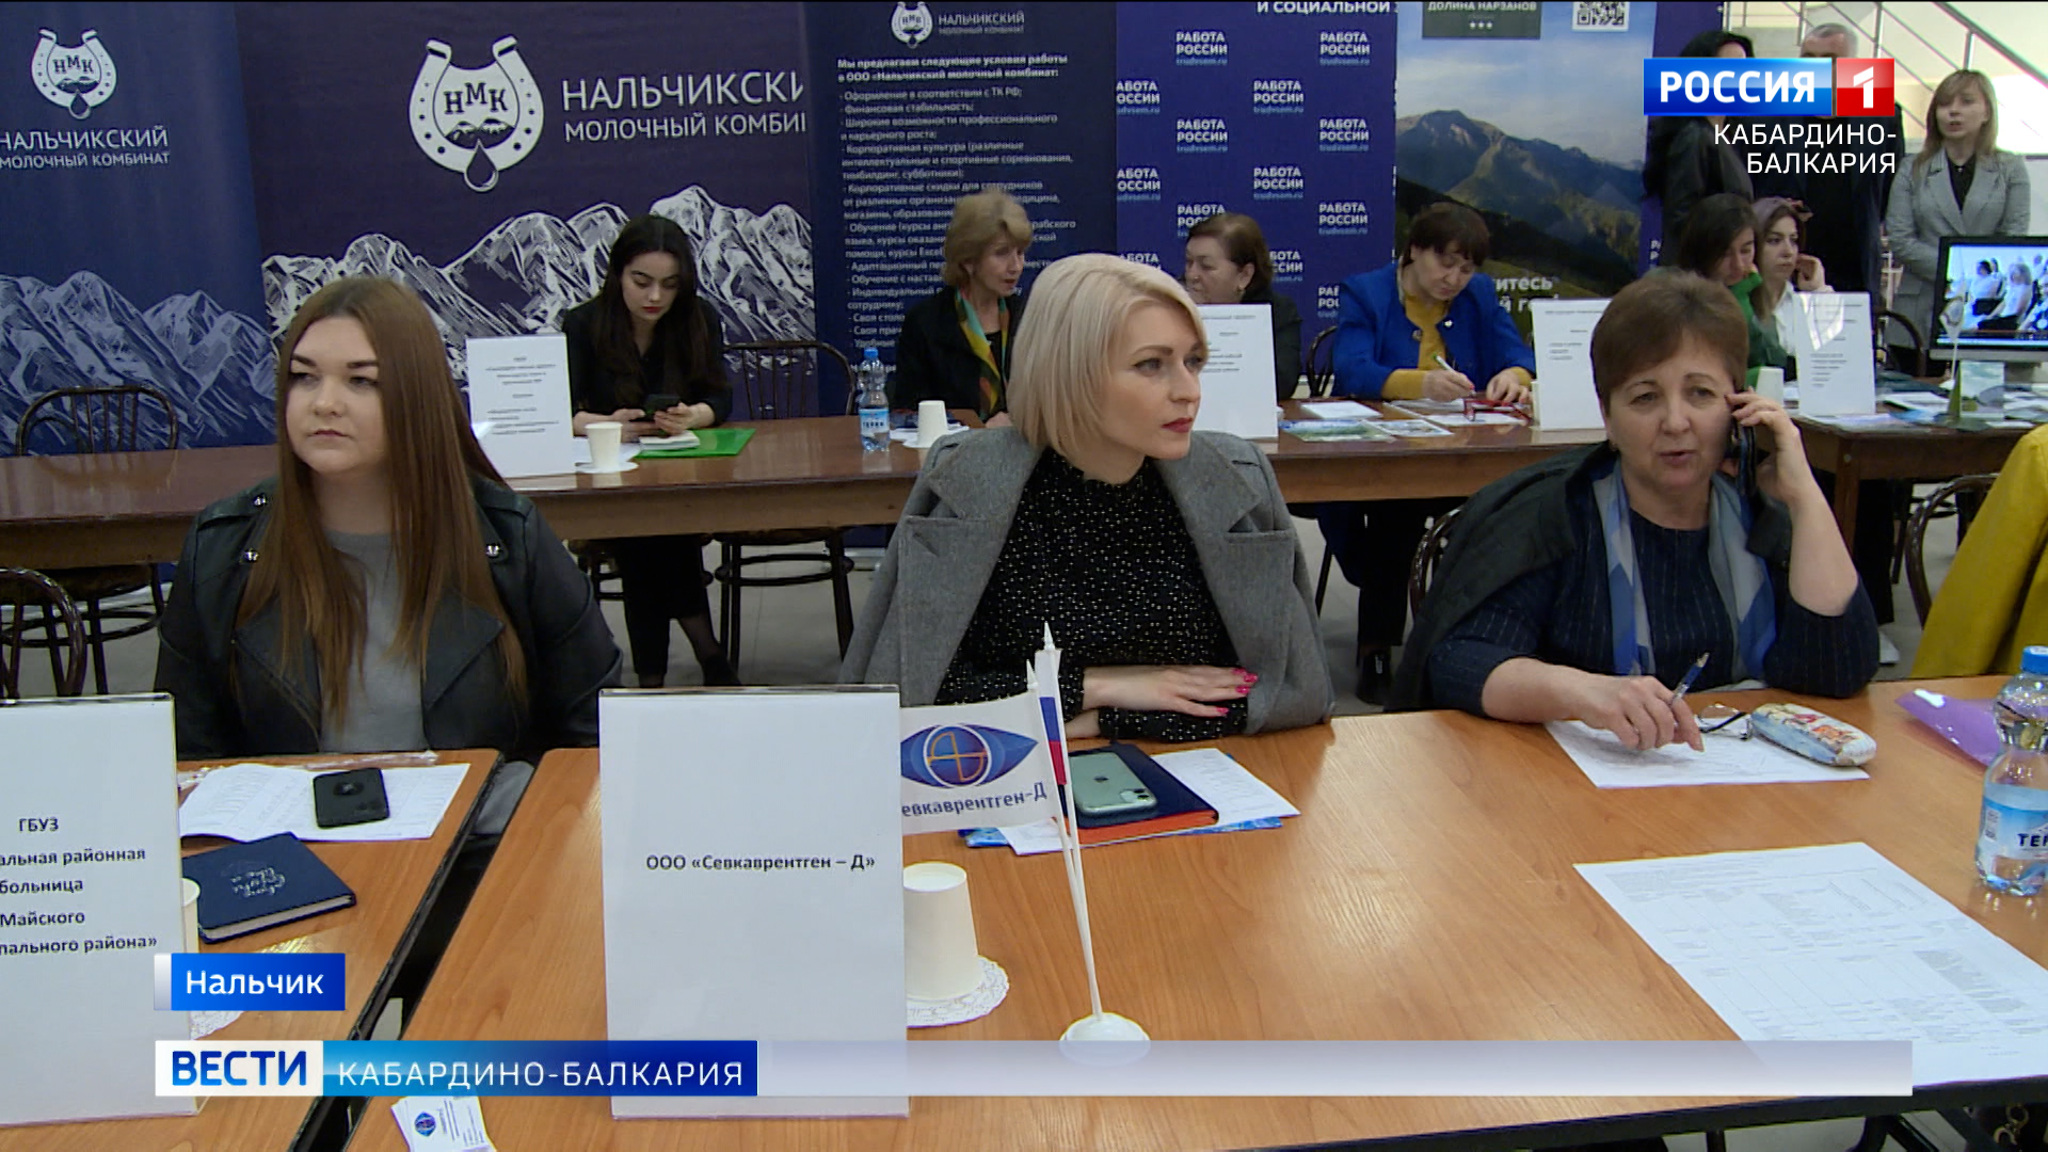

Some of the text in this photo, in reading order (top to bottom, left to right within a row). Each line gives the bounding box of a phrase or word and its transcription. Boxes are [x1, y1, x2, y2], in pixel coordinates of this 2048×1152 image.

[939, 11, 1024, 25] НАЛЬЧИКСКИЙ
[1176, 31, 1225, 42] РАБОТА
[1320, 31, 1368, 42] РАБОТА
[1176, 44, 1228, 55] РОССИИ
[1320, 44, 1370, 55] РОССИИ
[52, 55, 95, 74] НМК
[1028, 53, 1068, 65] работы
[846, 72, 871, 81] ООО
[1116, 80, 1158, 91] АБОТА
[1253, 80, 1302, 91] РАБОТА
[443, 82, 509, 114] НМК
[1116, 93, 1160, 104] ОССИИ
[1253, 92, 1304, 104] РОССИИ
[564, 112, 806, 143] МОЛОЧНЫЙ КОМБИ
[1176, 119, 1226, 130] РАБОТА
[1319, 118, 1367, 129] РАБОТА
[0, 125, 169, 150] НАЛЬЧИКСКИЙ
[1177, 131, 1228, 143] РОССИИ
[1319, 131, 1369, 142] РОССИИ
[0, 152, 170, 168] МОЛОЧНЫЙ КОМБИНАТ
[1116, 168, 1159, 179] АБОТА
[1253, 167, 1302, 178] РАБОТА
[1117, 180, 1161, 192] ОССИИ
[1253, 178, 1304, 190] РОССИИ
[1177, 204, 1226, 215] РАБОТА
[1318, 202, 1366, 213] РАБОТА
[1318, 214, 1368, 226] РОССИИ
[901, 780, 1047, 817] евкаврентген-Д
[18, 817, 59, 832] ГБУЗ
[62, 848, 146, 867] районная
[646, 854, 686, 870] ООО
[692, 854, 832, 872] «Севкаврентген
[850, 854, 875, 872] Д»
[0, 879, 83, 894] больница
[0, 910, 86, 927] Майского
[84, 935, 157, 953] района»
